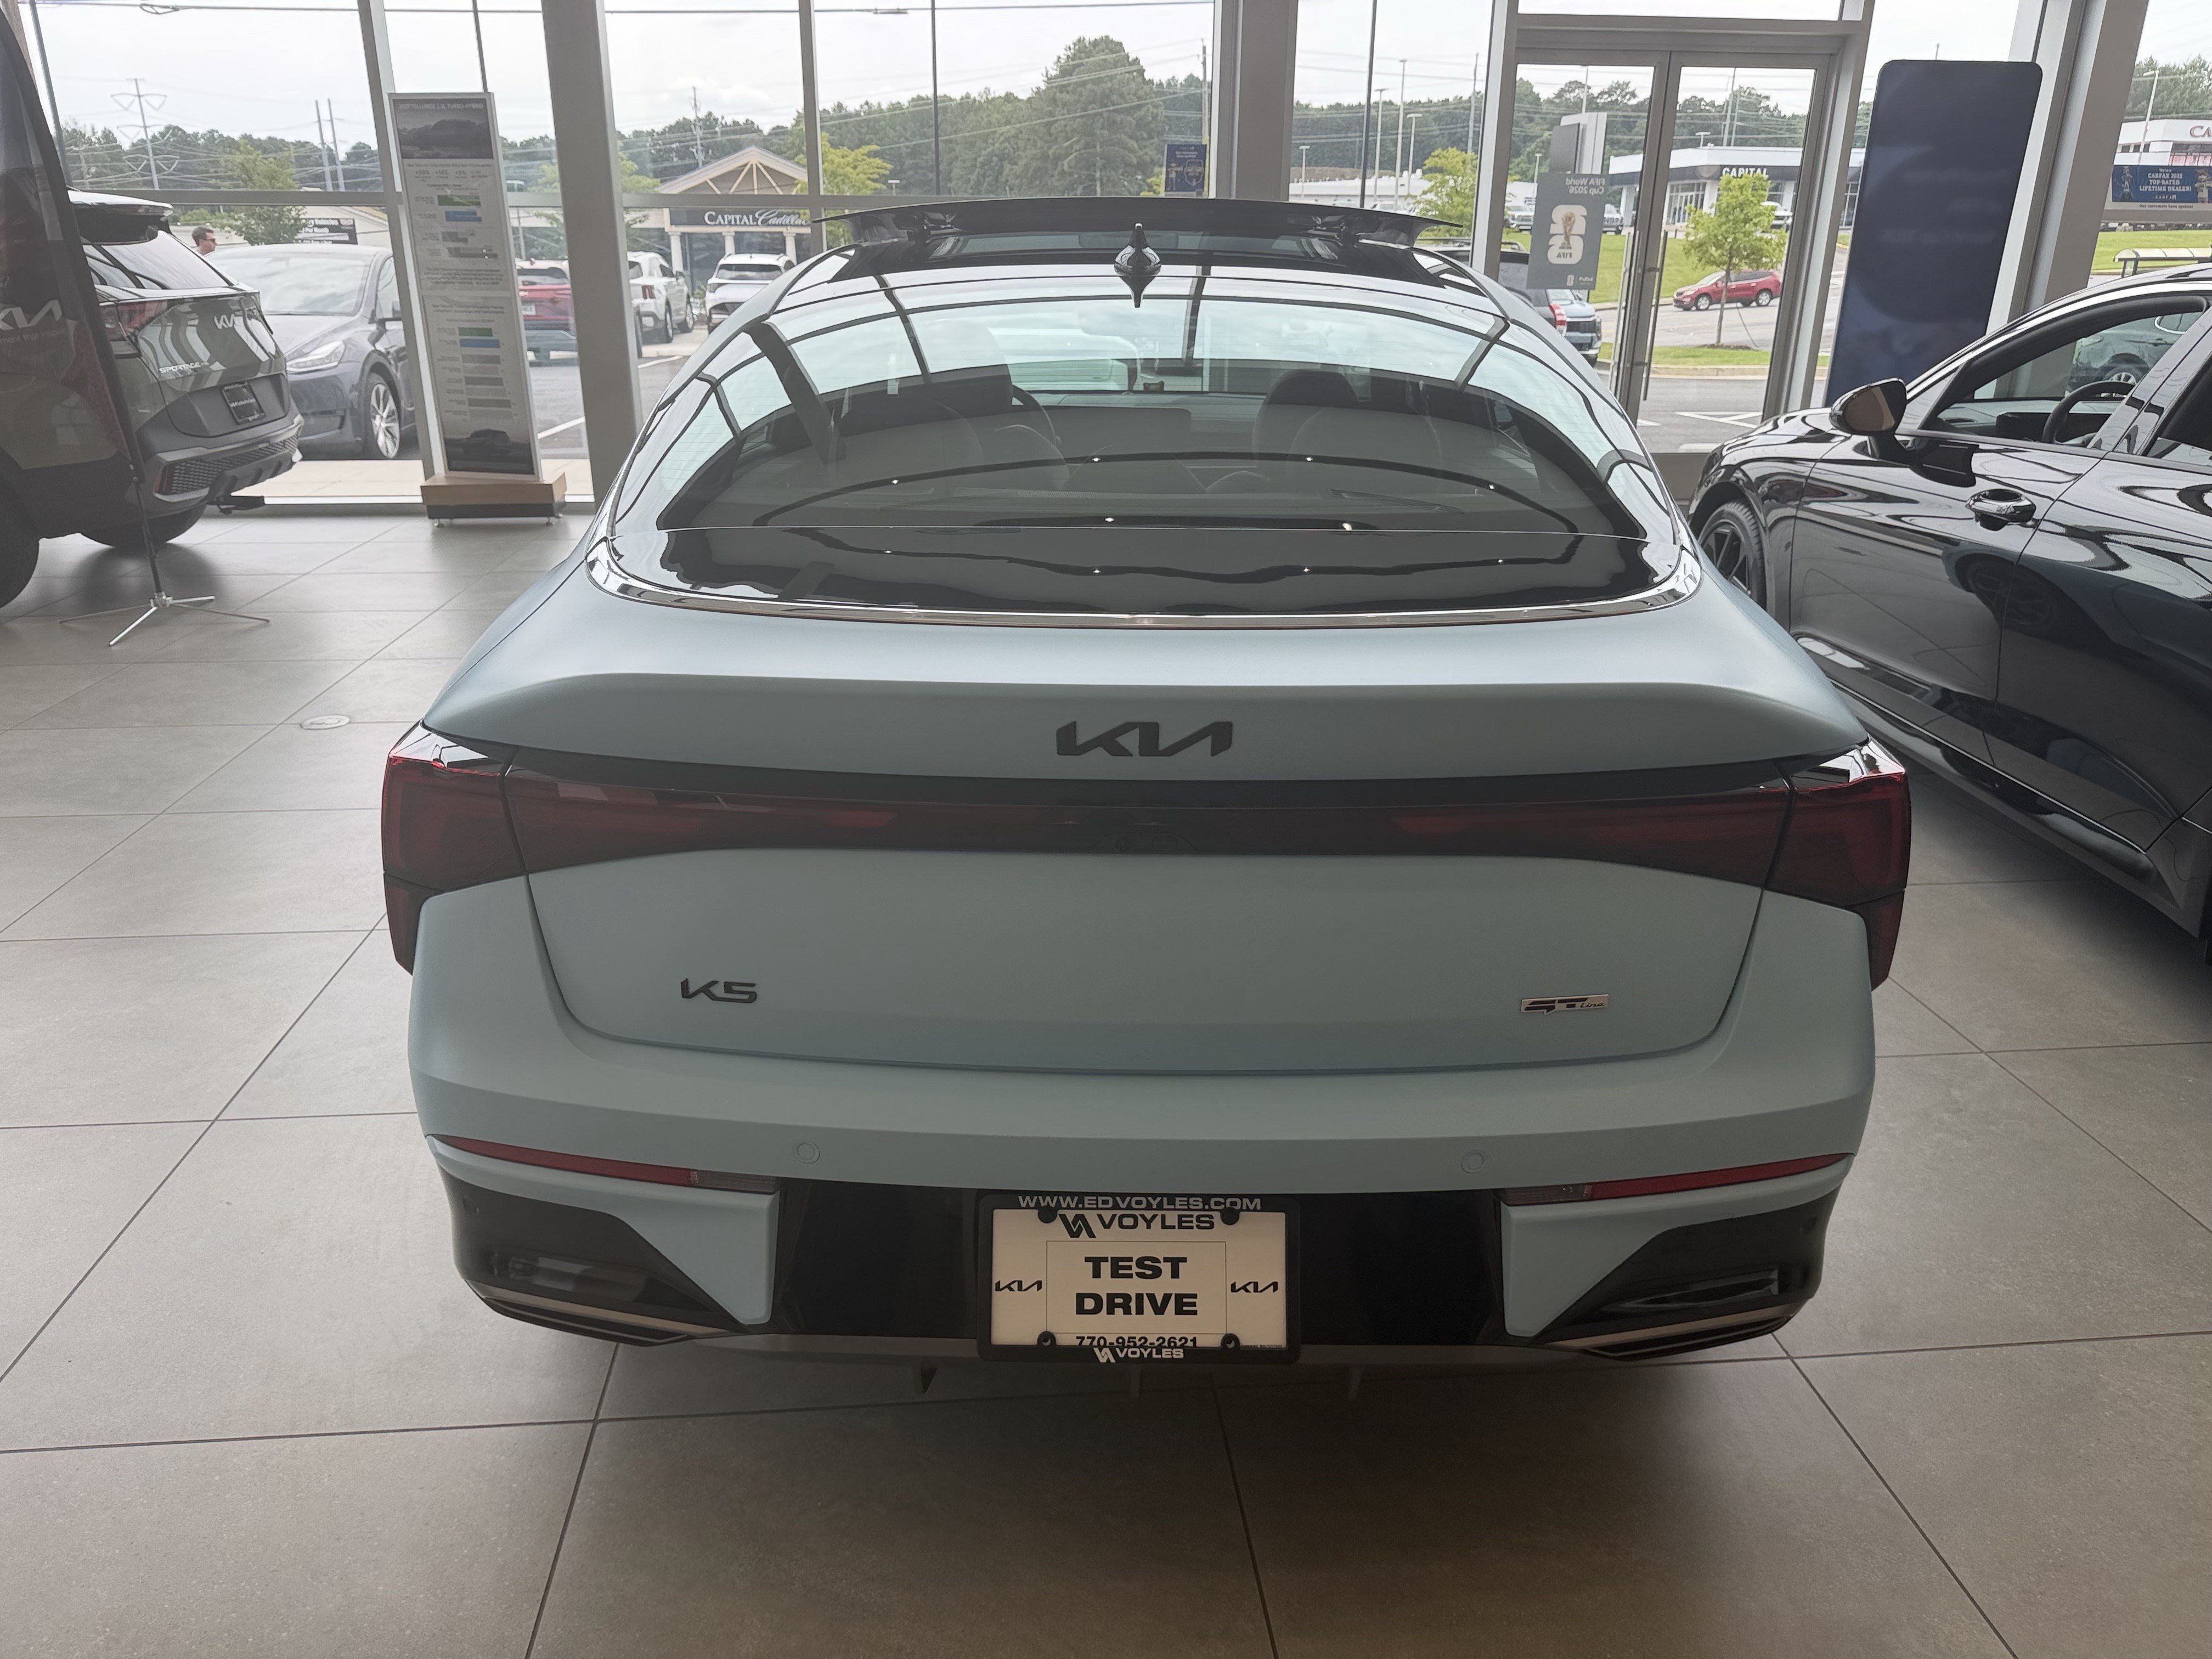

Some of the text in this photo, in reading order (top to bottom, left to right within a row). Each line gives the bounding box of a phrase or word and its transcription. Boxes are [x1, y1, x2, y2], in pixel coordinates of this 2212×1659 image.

[704, 209, 808, 227] CAPITAL Cadillac
[159, 362, 201, 374] SPORTAGE
[1057, 721, 1233, 757] KIA
[680, 978, 757, 1003] K5
[1018, 1195, 1261, 1211] WWW.EDVOYLES.COM
[1097, 1213, 1215, 1229] VOYLES
[1084, 1256, 1188, 1279] TEST
[995, 1280, 1043, 1293] KIA
[1230, 1281, 1279, 1294] KIA
[1075, 1293, 1198, 1316] DRIVE
[1076, 1336, 1198, 1347] 770-952-2621
[1115, 1347, 1184, 1358] VOYLES
